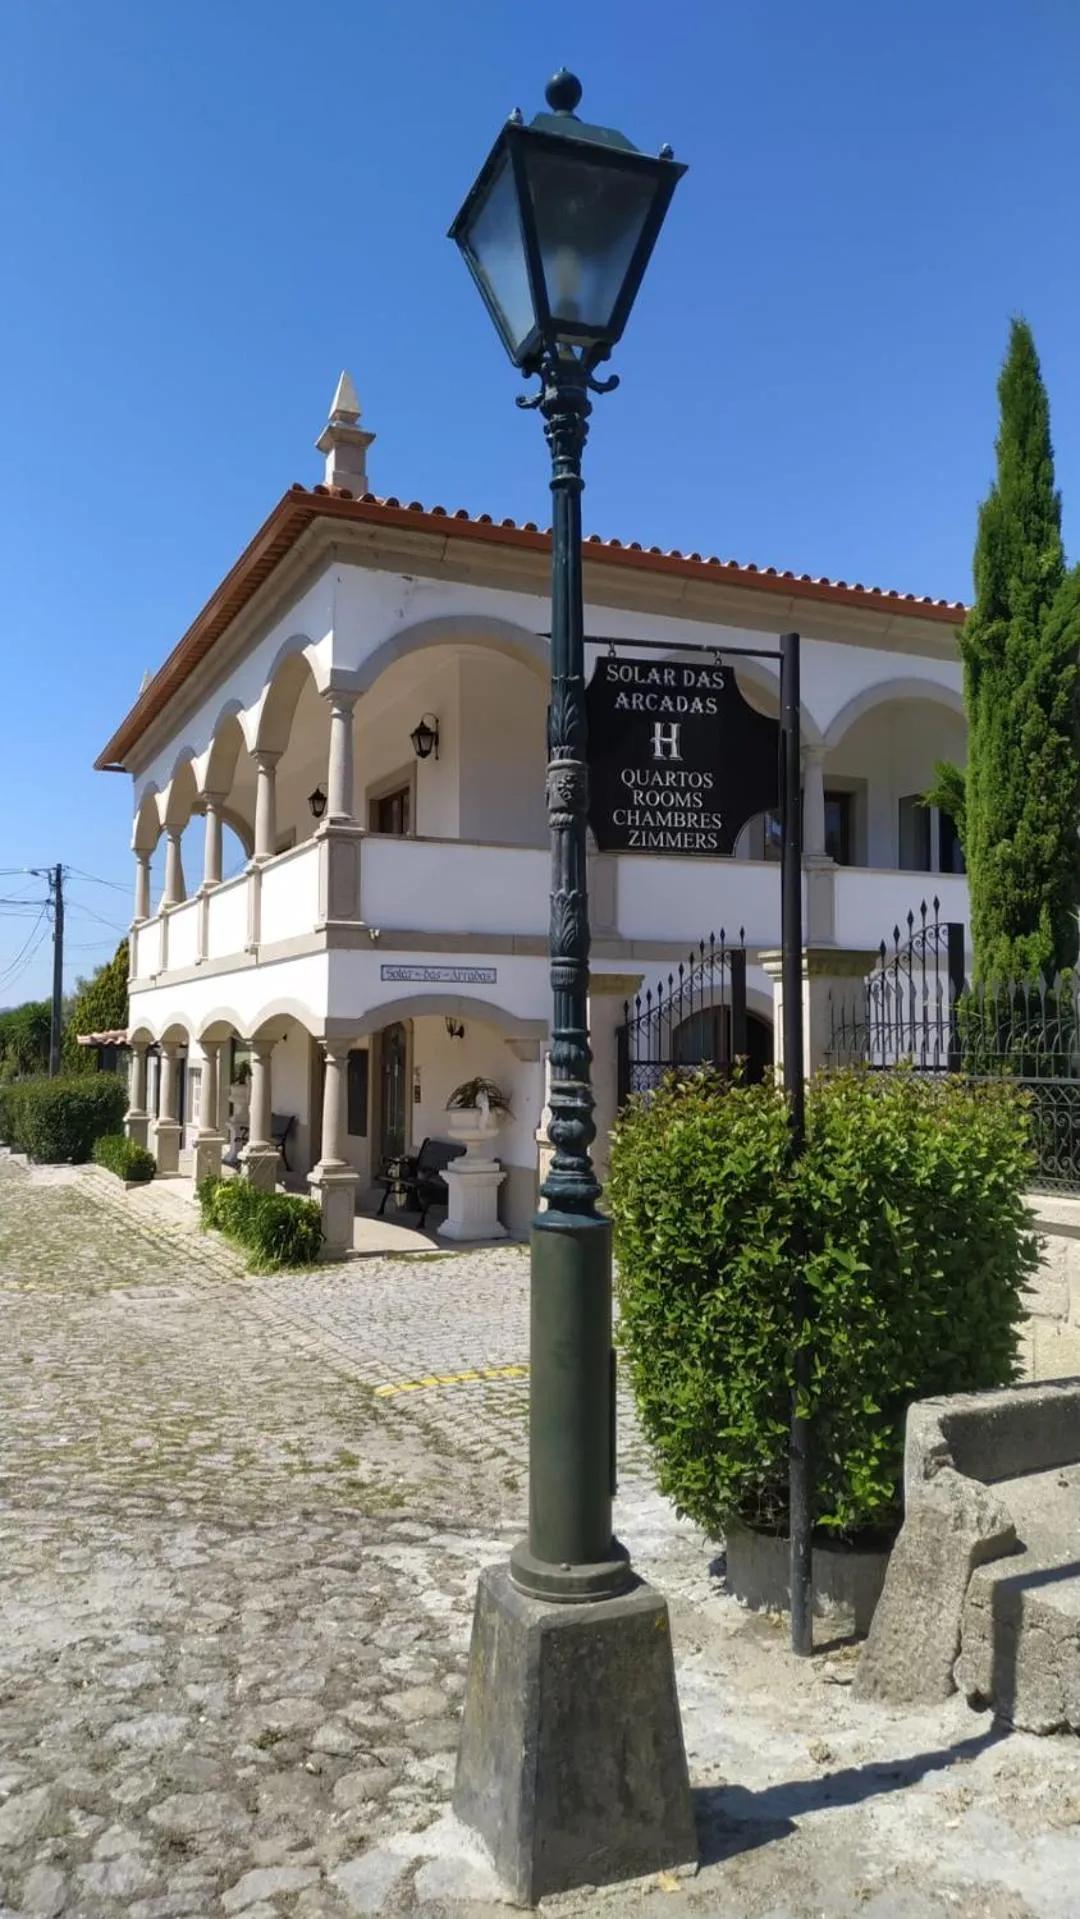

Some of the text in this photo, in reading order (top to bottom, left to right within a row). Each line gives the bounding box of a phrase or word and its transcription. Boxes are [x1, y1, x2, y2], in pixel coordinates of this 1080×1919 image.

[607, 664, 725, 689] SOLAR DAS
[614, 692, 718, 714] ARCADAS
[650, 722, 683, 760] H
[621, 769, 713, 789] QUARTOS
[634, 790, 703, 808] ROOMS
[613, 810, 722, 829] CHAMBRES
[628, 830, 718, 849] ZIMMERS
